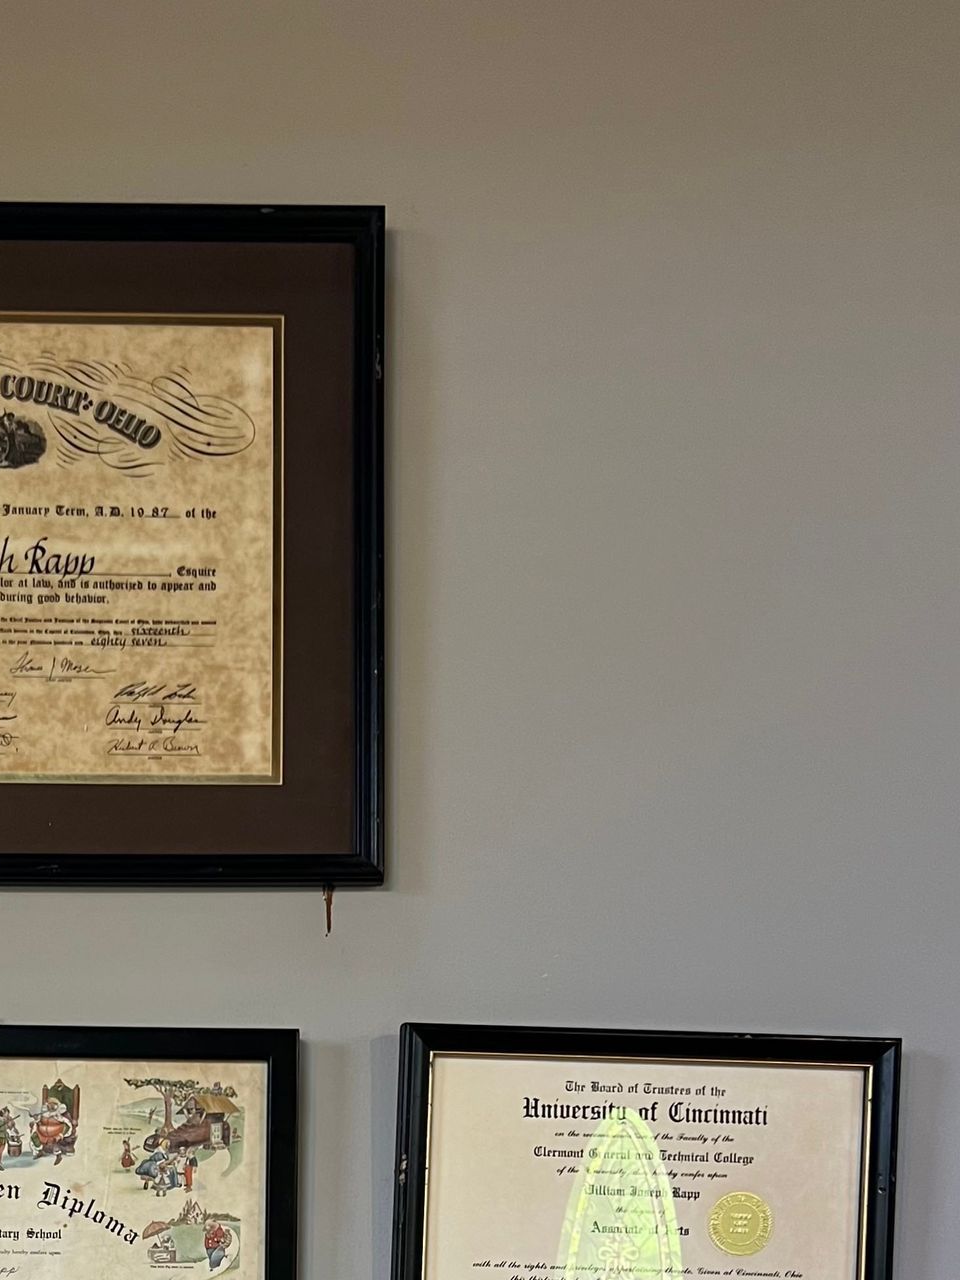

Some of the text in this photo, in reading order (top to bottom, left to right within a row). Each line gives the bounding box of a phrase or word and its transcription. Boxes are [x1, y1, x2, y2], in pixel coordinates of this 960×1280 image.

[0, 374, 88, 416] COURT
[94, 400, 162, 449] OHIO
[2, 504, 49, 518] January
[55, 505, 89, 517] Term,
[185, 508, 196, 518] of
[201, 508, 216, 519] the
[25, 537, 95, 584] Rapp
[177, 566, 216, 578] Esquire
[18, 579, 28, 588] at
[33, 578, 53, 589] law,
[58, 579, 76, 588] and
[81, 580, 89, 588] is
[92, 580, 143, 591] authorized
[148, 581, 156, 590] to
[161, 582, 194, 592] appear
[199, 581, 216, 591] and
[131, 626, 190, 635] sixteenth
[91, 637, 126, 650] eighty
[131, 638, 167, 647] seven
[565, 1081, 726, 1098] The Board of Trustees of the
[523, 1097, 768, 1125] University of Cincinnati
[534, 1146, 584, 1158] Clermont
[659, 1150, 709, 1162] Technical
[714, 1152, 754, 1166] College
[672, 1187, 700, 1199] Rapp
[37, 1182, 139, 1244] Diploma
[26, 1228, 62, 1240] School
